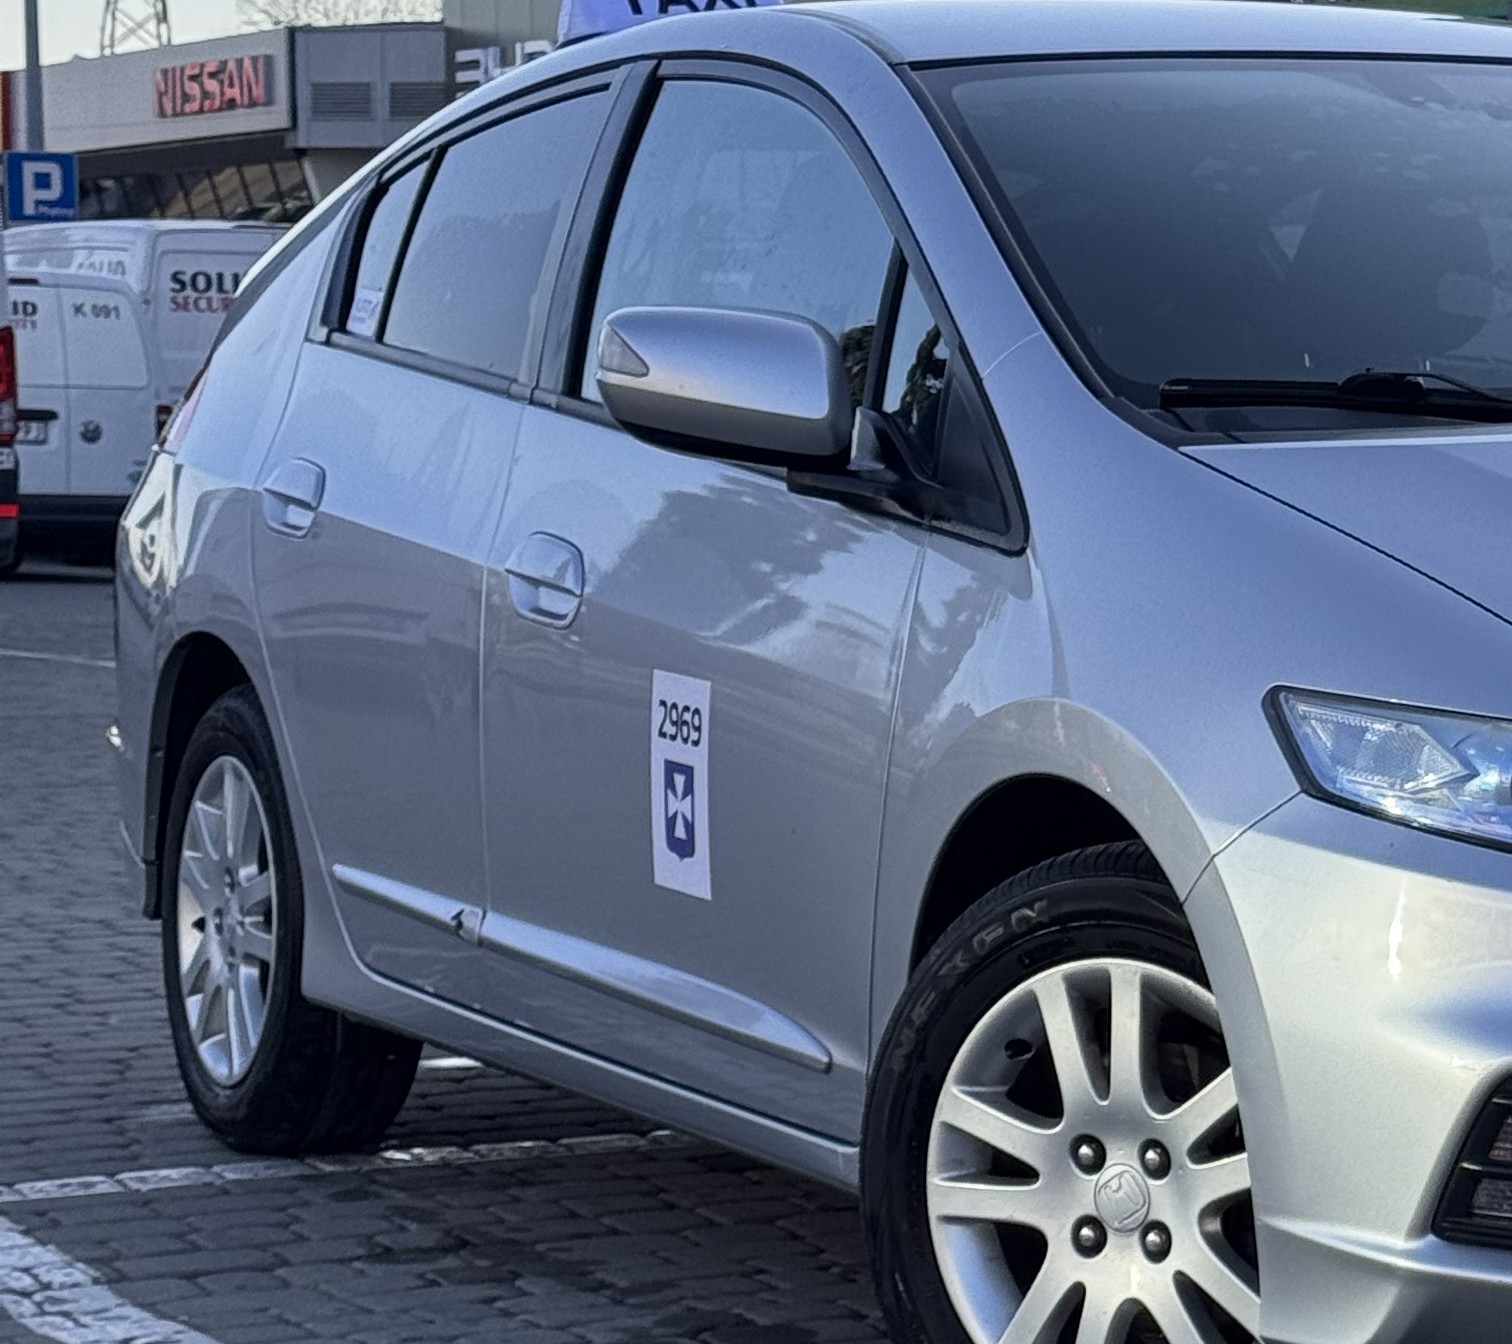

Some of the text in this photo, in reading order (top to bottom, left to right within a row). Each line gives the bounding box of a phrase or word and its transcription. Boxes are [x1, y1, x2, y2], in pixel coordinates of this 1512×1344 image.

[154, 54, 270, 119] NISSAN
[21, 160, 64, 217] P
[657, 699, 702, 748] 2969
